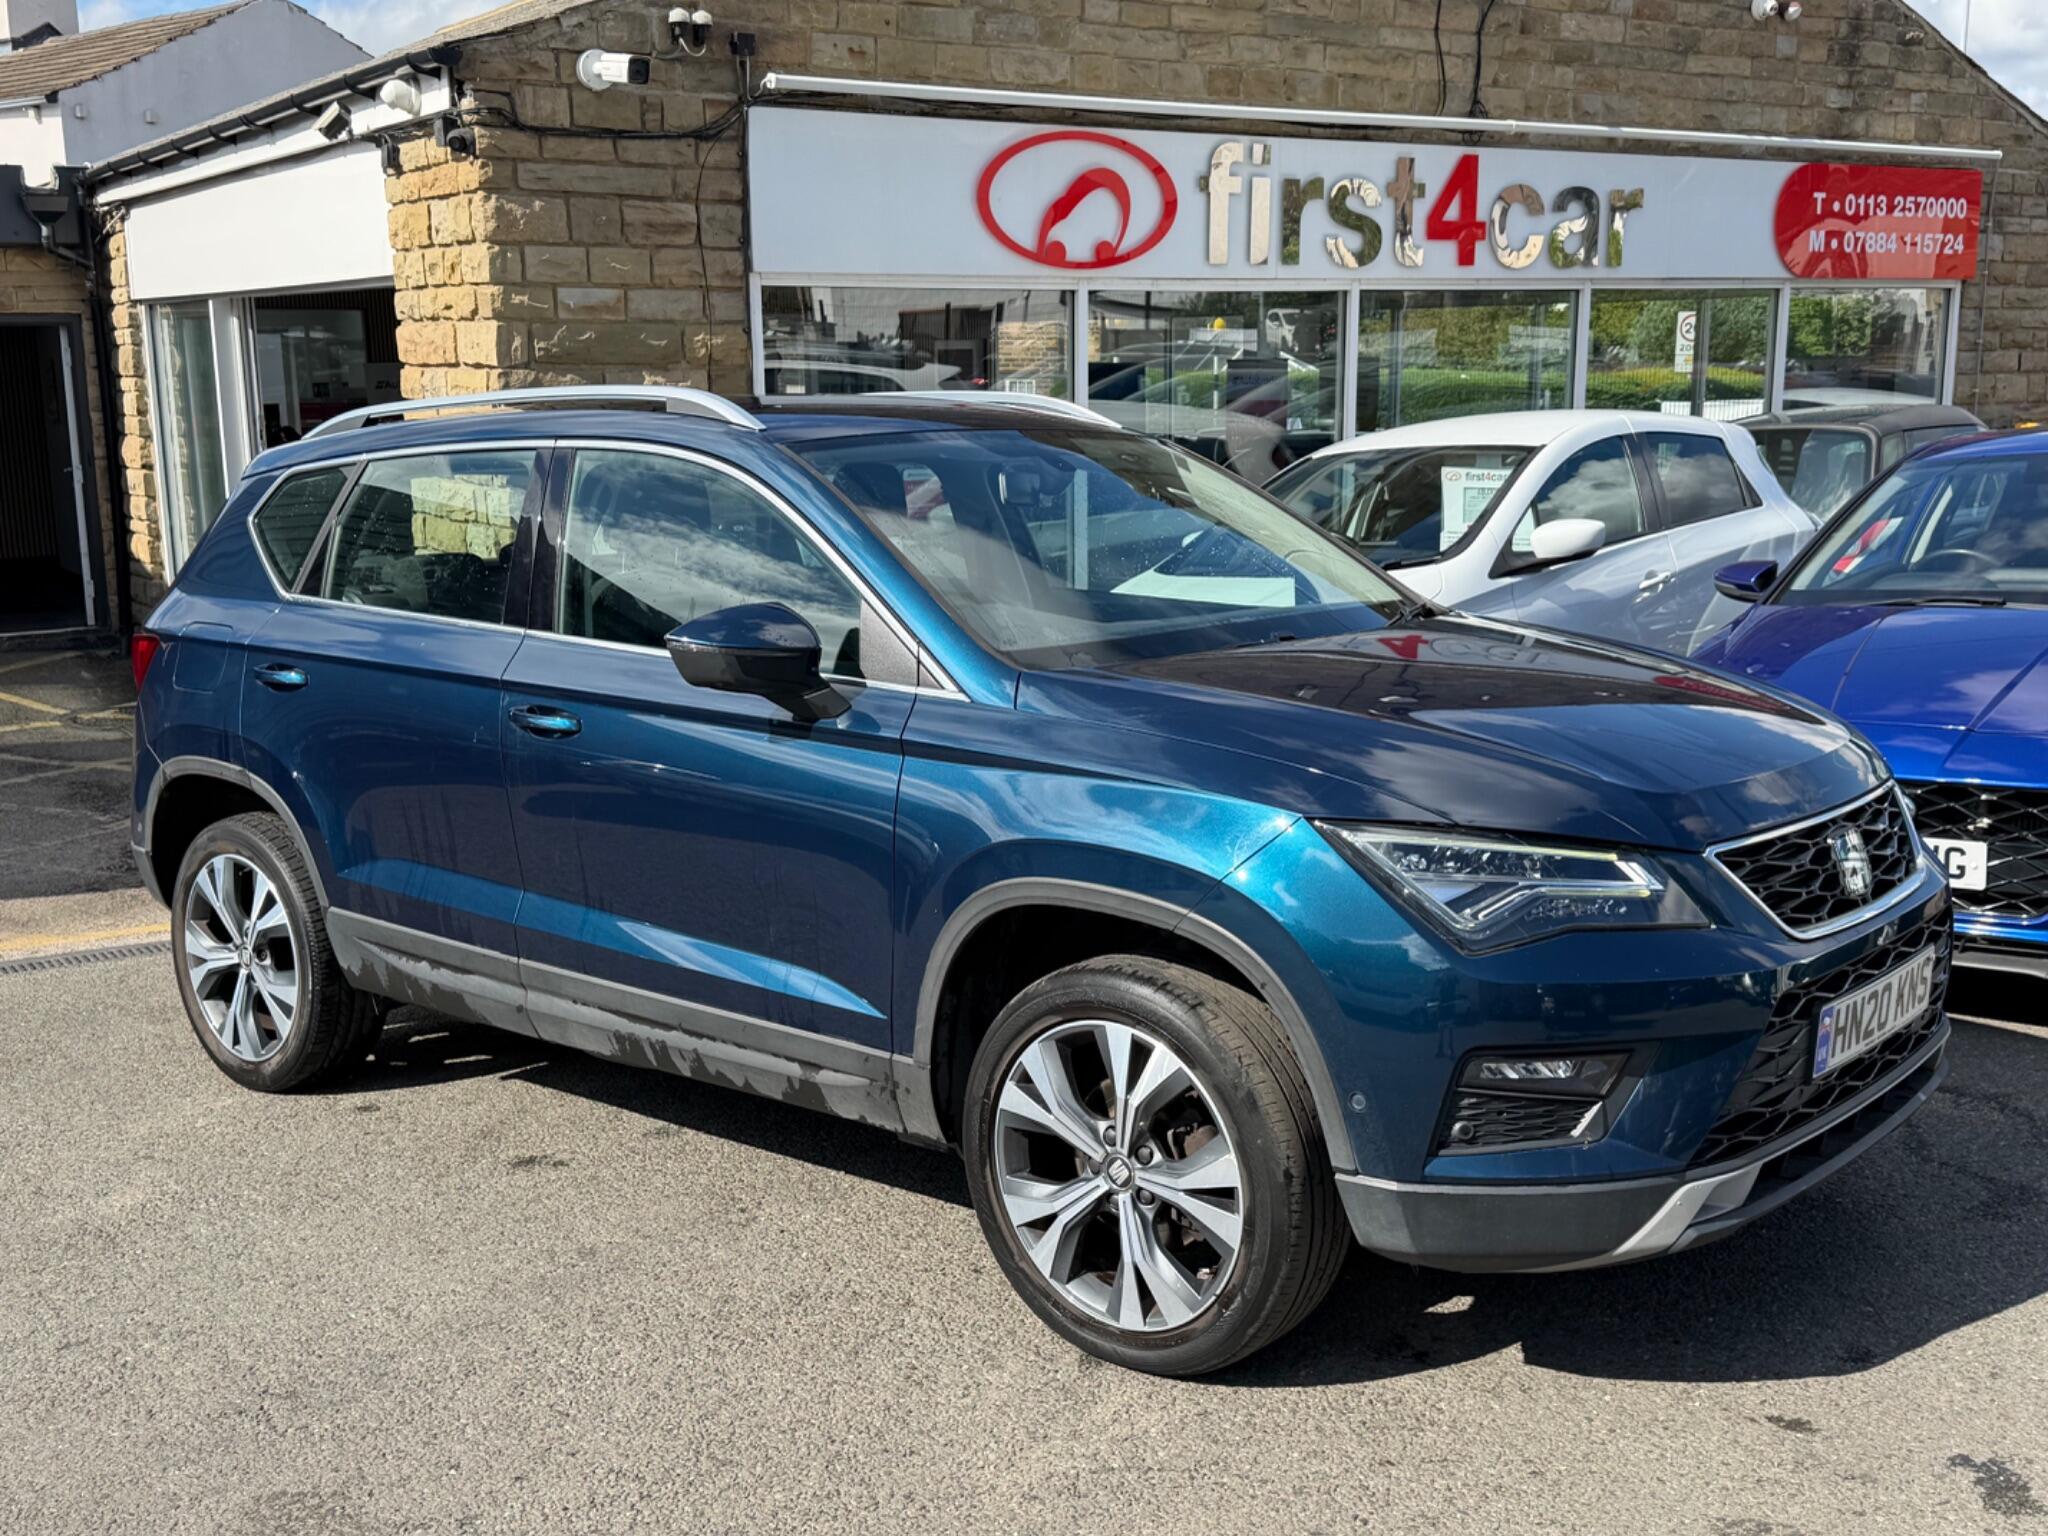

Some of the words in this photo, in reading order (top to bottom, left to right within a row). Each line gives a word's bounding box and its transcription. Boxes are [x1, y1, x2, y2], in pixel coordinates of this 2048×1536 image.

[1199, 141, 1645, 269] first4car
[1813, 192, 1826, 215] T
[1845, 194, 1887, 216] 0113
[1893, 196, 1967, 218] 2570000
[1809, 230, 1825, 253] M
[1843, 231, 1897, 254] 07884
[1904, 233, 1964, 254] 115724
[1933, 845, 1966, 880] G
[1831, 981, 1893, 1059] HN20
[1894, 958, 1933, 1023] KNS
